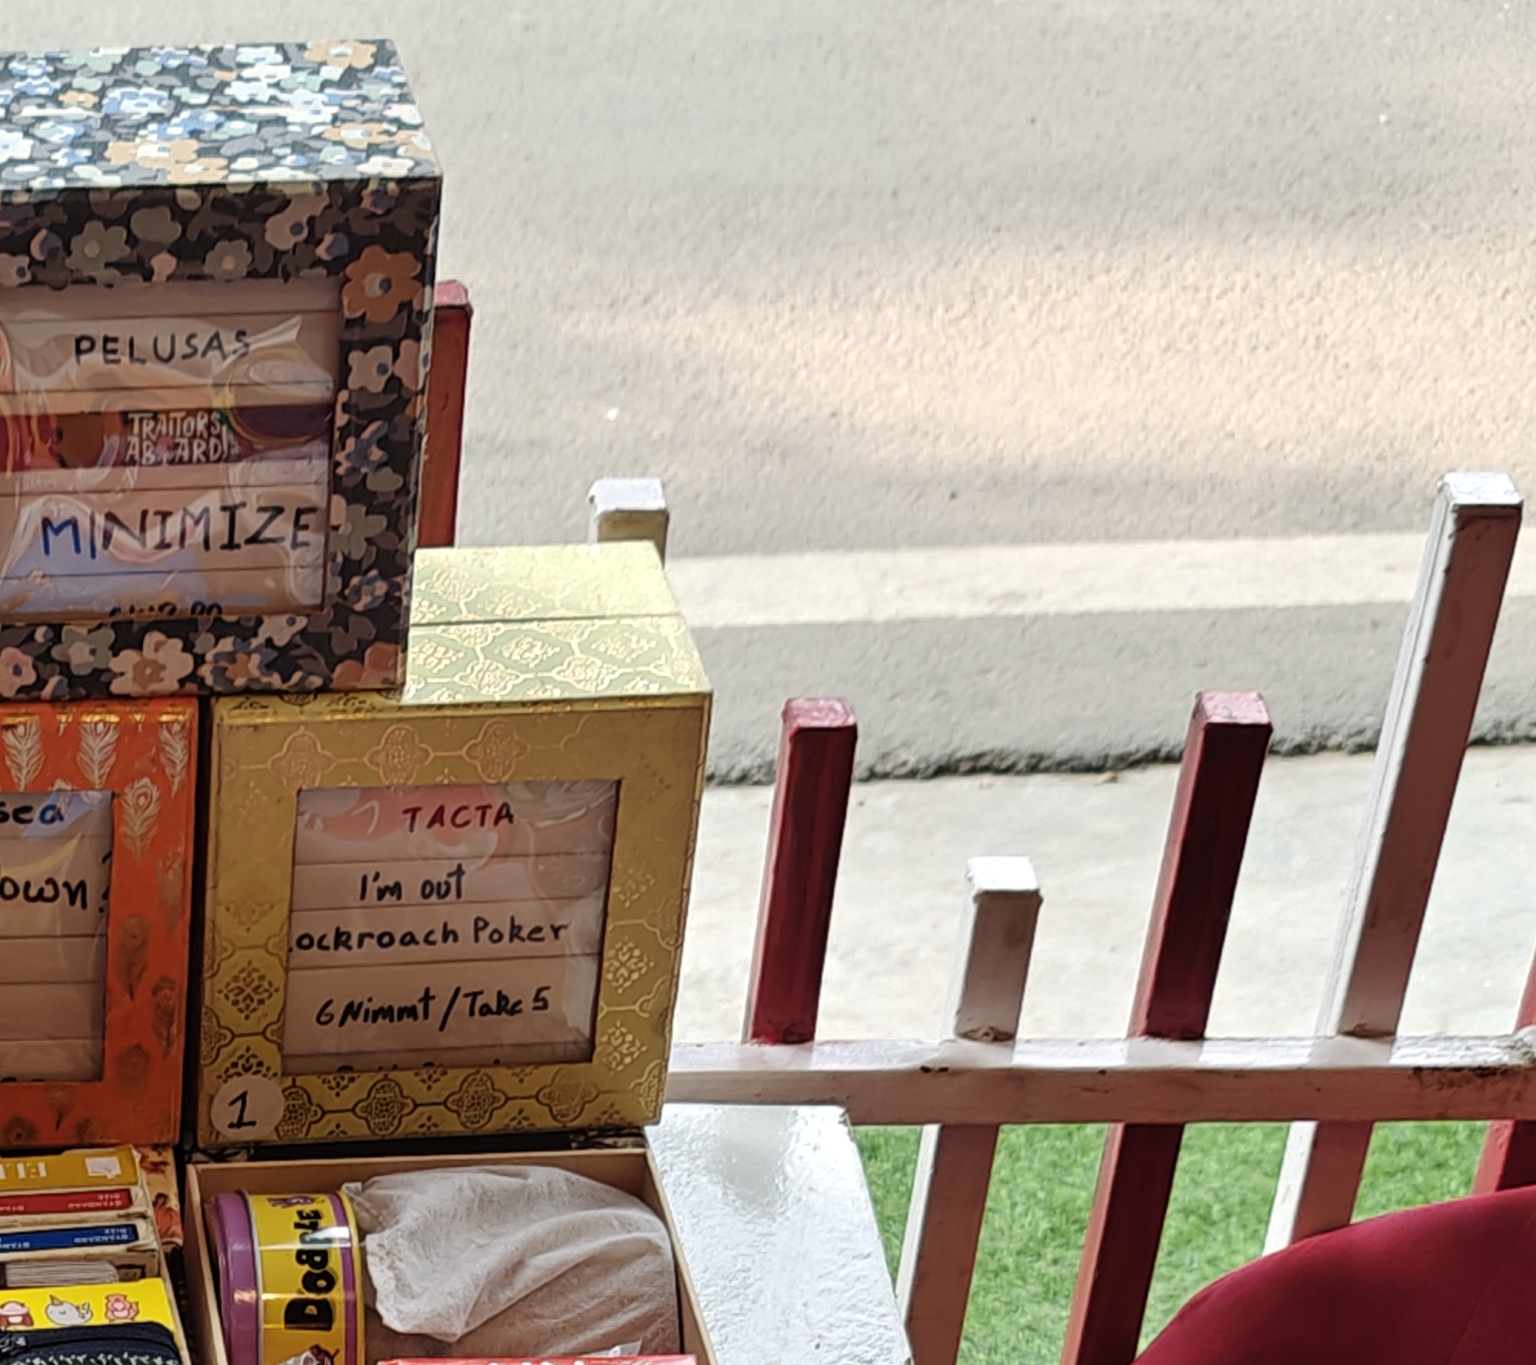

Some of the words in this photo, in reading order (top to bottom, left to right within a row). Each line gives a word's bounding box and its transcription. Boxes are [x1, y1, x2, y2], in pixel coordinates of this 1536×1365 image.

[74, 329, 250, 365] PELUSAS
[127, 410, 222, 441] TRAITORS
[41, 502, 318, 560] MINIMIZE
[402, 801, 515, 835] TACTA
[359, 871, 403, 902] I'm
[420, 863, 467, 901] out
[288, 921, 460, 954] ockroach
[473, 915, 569, 945] Poker
[226, 1089, 257, 1131] 1
